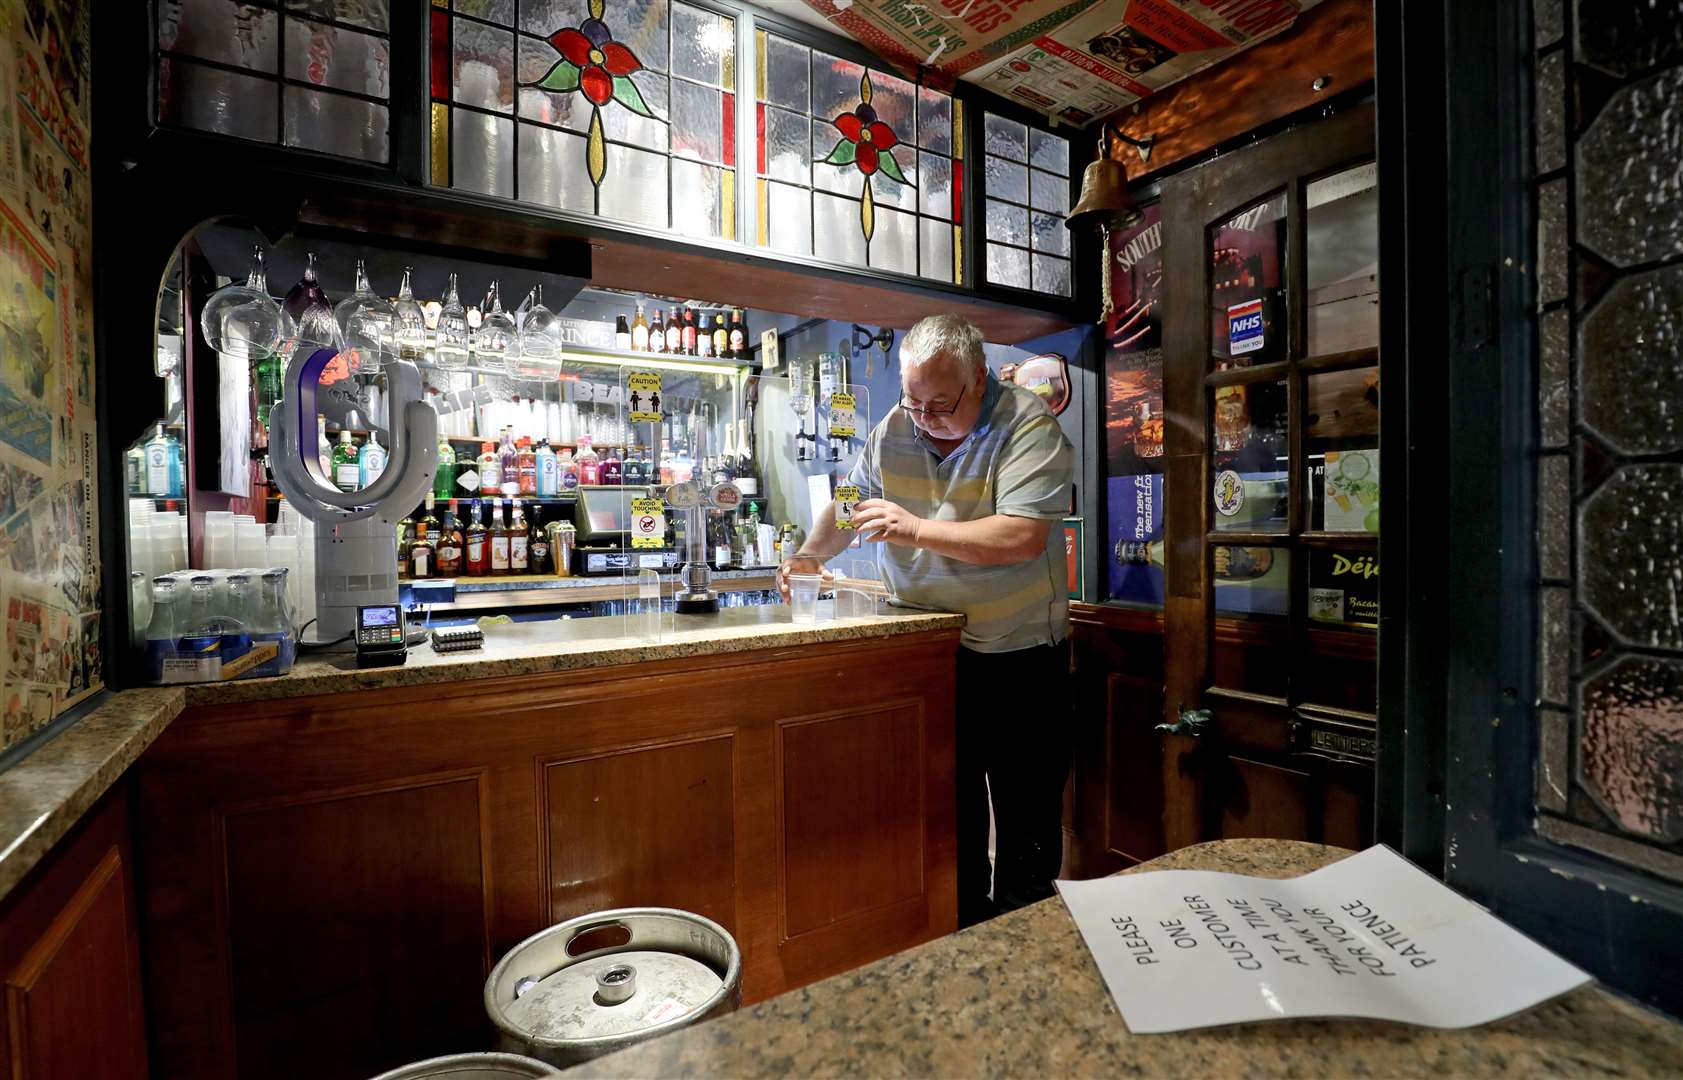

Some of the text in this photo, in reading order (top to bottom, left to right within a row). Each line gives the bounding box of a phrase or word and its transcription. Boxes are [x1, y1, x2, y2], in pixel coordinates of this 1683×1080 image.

[1116, 221, 1161, 273] SOUTH
[1232, 315, 1260, 333] NHS
[631, 377, 658, 385] CAUTION
[85, 483, 91, 501] ON
[1135, 517, 1144, 538] The
[1311, 730, 1377, 754] LETTERS
[1111, 915, 1160, 965] PLEASE
[1160, 918, 1197, 949] ONE
[1183, 895, 1262, 971] CUSTOMER
[1226, 897, 1309, 966] AT A TIME
[1259, 897, 1357, 976] THANK YOU
[1303, 906, 1396, 977] FOR YOUR
[1340, 900, 1437, 969] PATIENCE
